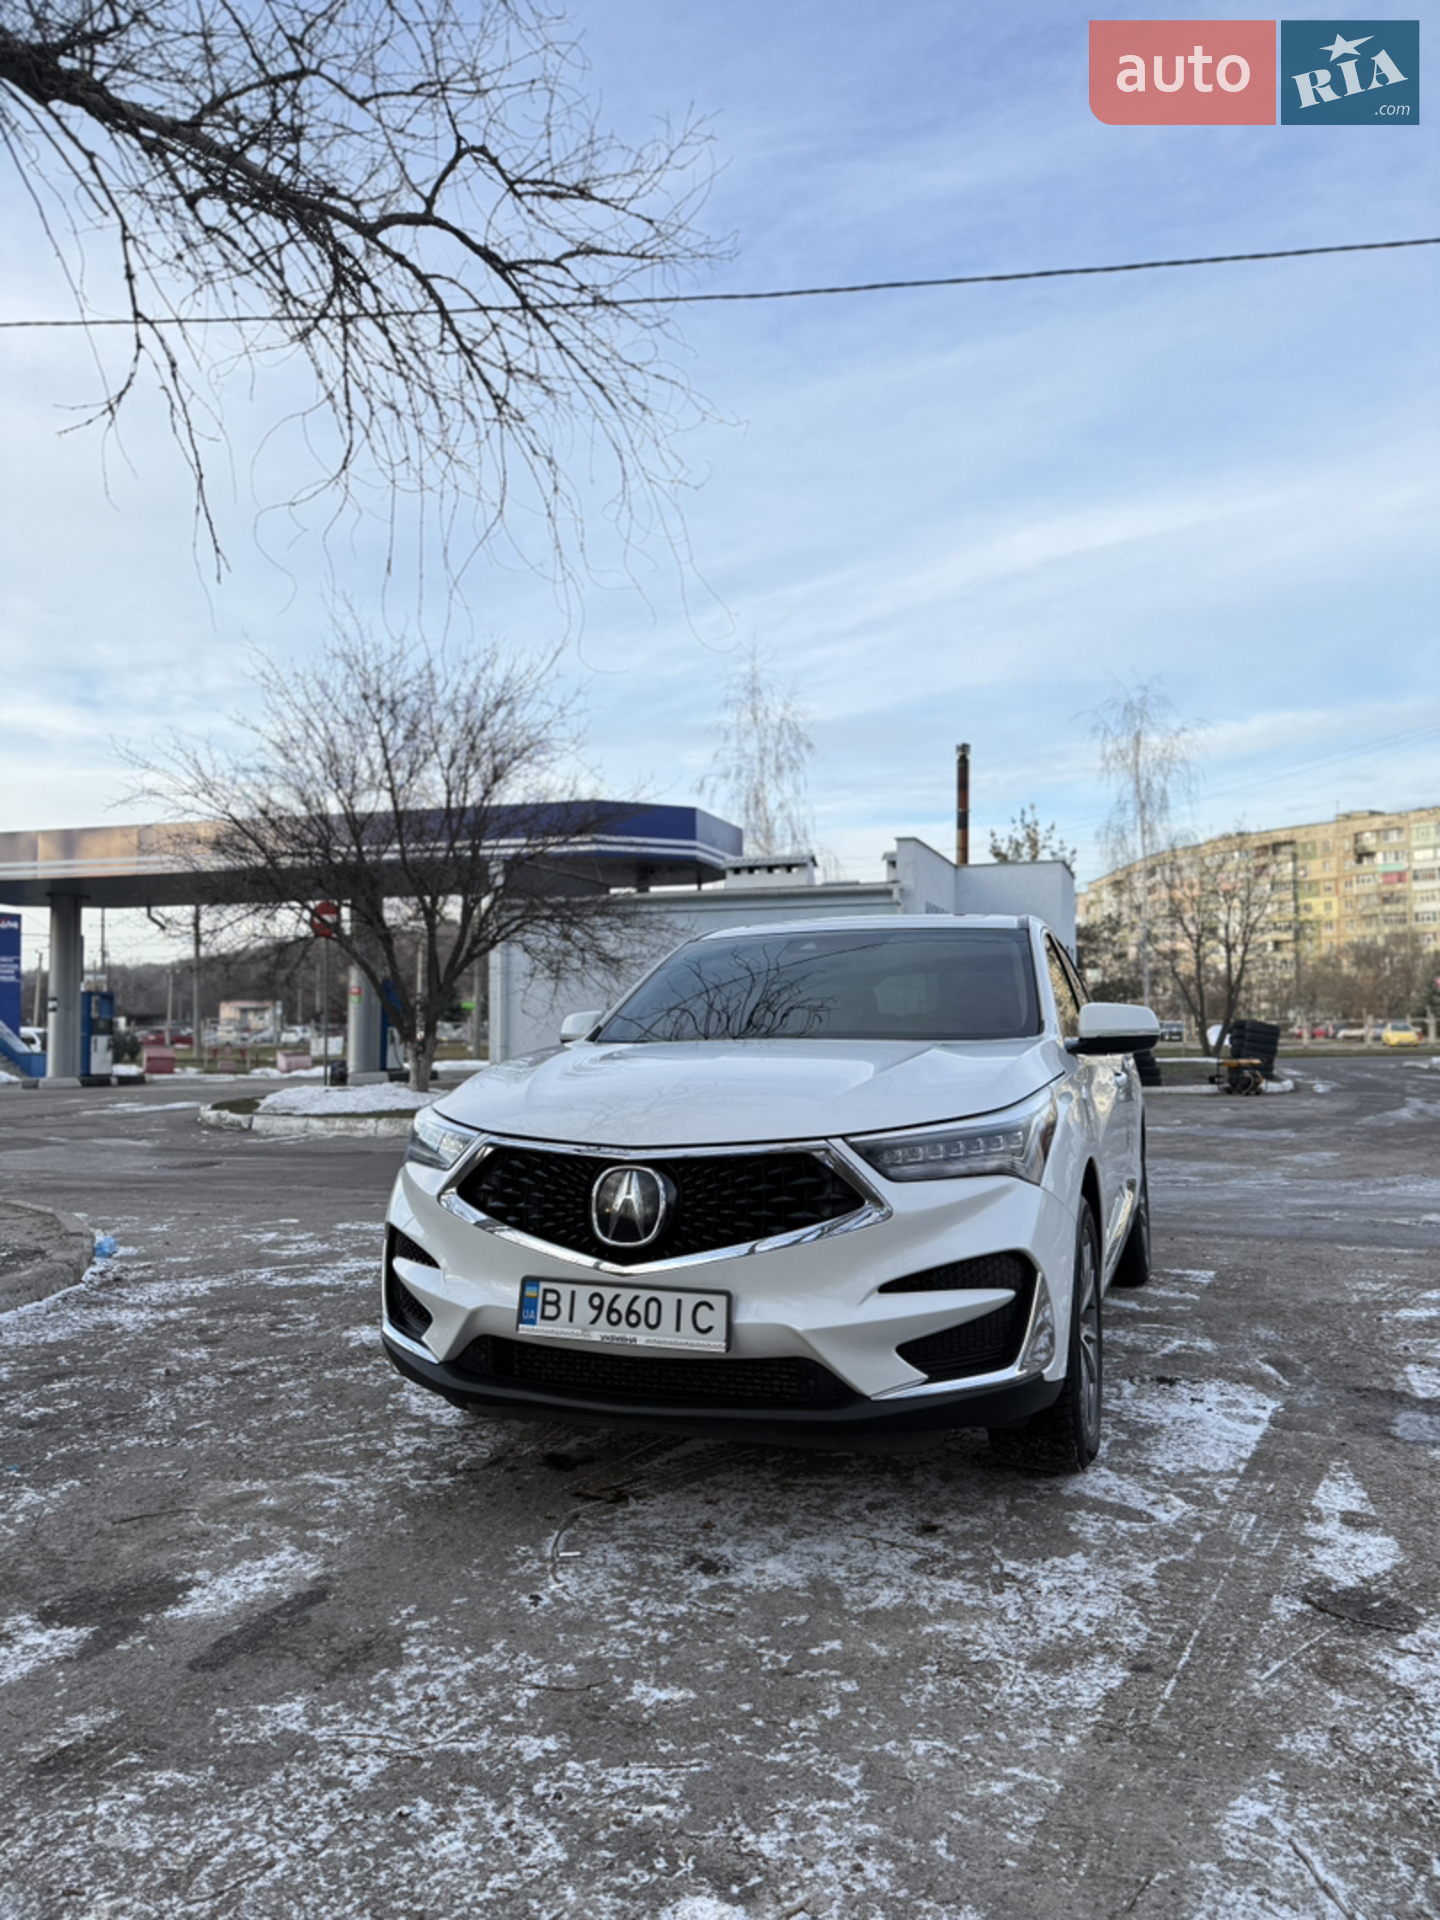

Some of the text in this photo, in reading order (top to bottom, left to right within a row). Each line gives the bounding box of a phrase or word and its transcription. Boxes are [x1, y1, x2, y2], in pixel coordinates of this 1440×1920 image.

[522, 1309, 536, 1320] UA
[540, 1288, 715, 1334] BI 9660 IC
